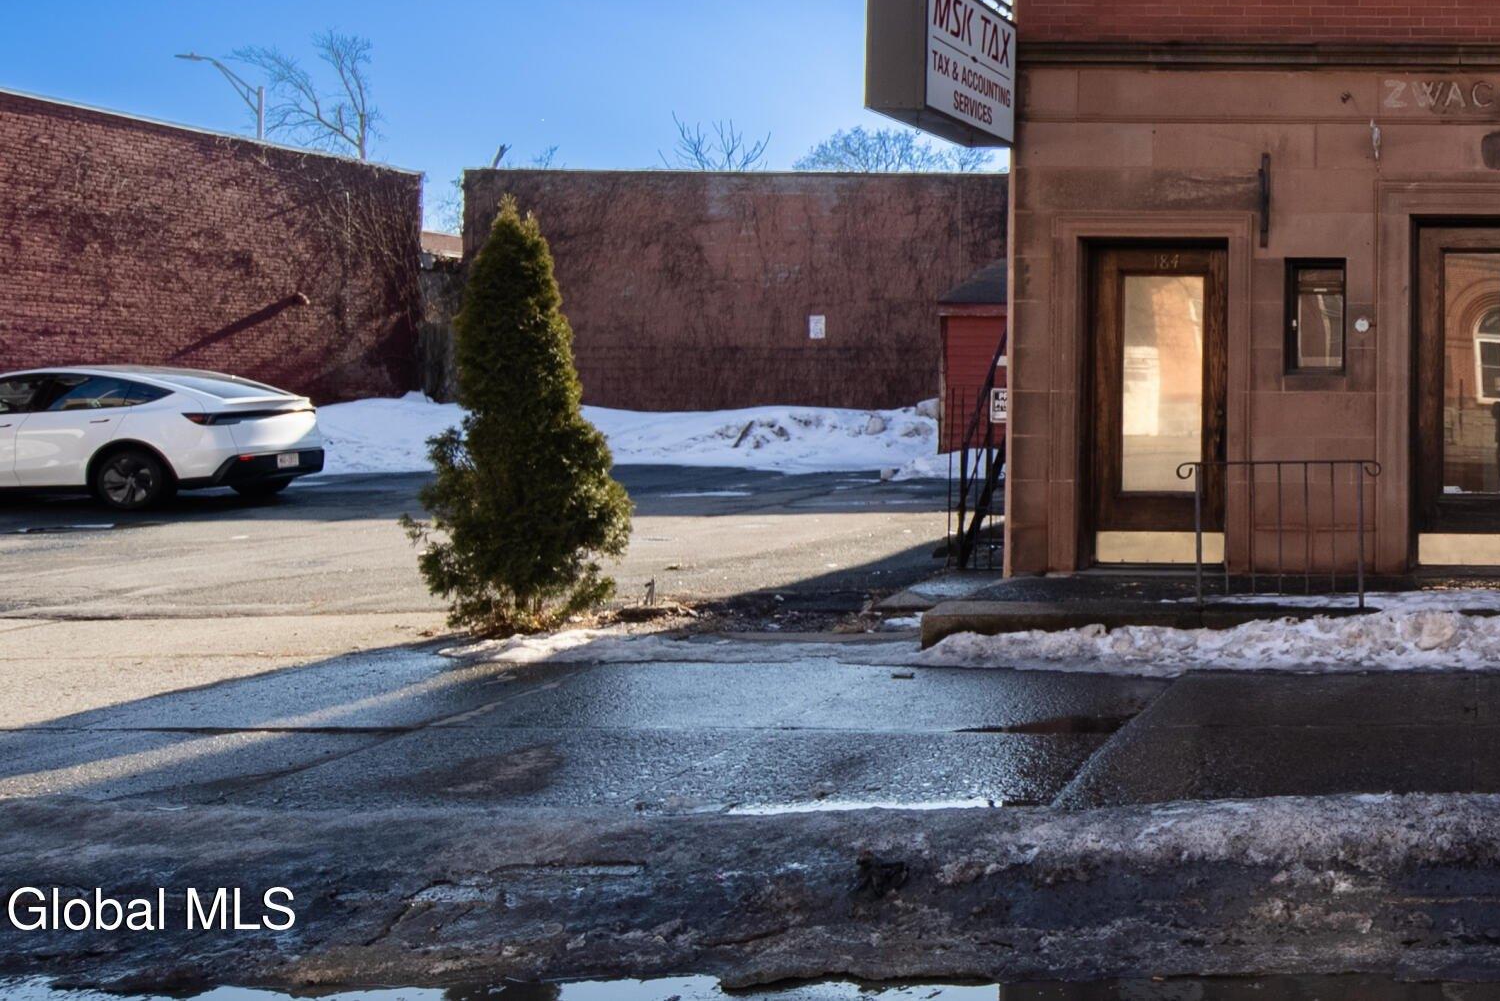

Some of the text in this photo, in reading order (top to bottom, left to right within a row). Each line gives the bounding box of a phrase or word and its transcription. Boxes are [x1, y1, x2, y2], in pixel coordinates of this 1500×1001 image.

[980, 14, 1010, 69] TAX
[932, 49, 1011, 109] TAX & ACCOUNTING
[953, 89, 993, 126] SERVICES
[1153, 253, 1180, 269] 184
